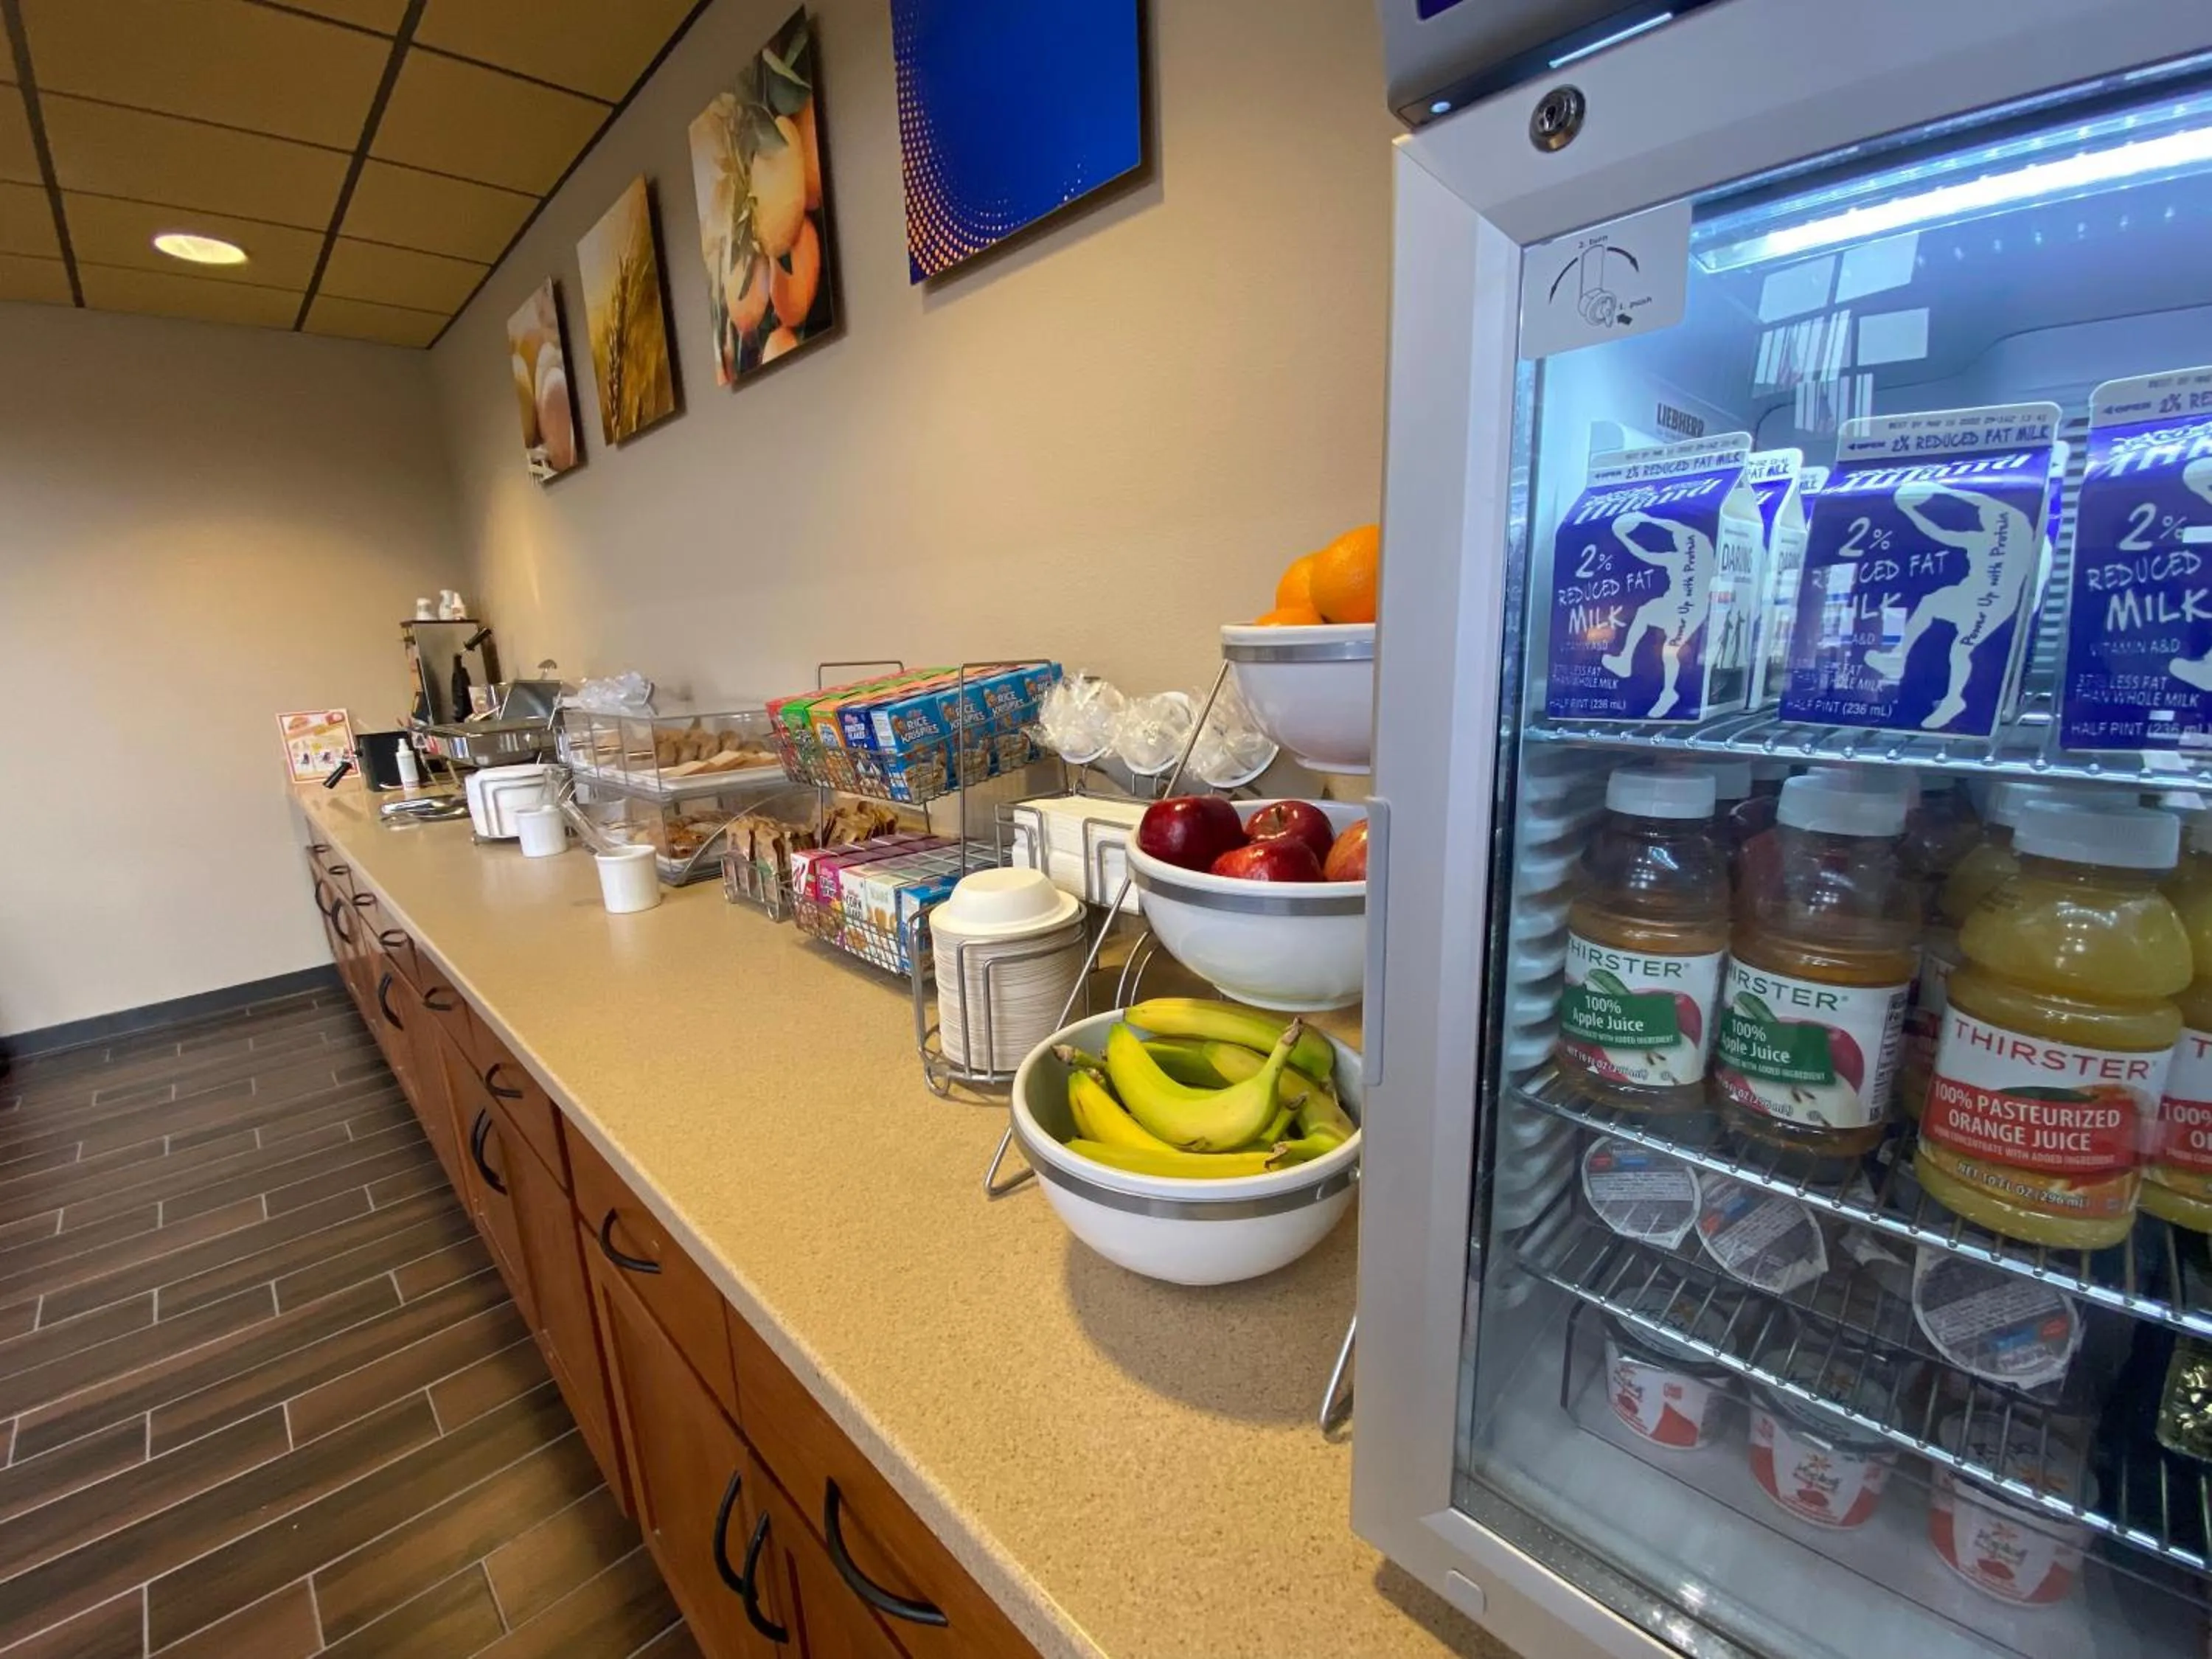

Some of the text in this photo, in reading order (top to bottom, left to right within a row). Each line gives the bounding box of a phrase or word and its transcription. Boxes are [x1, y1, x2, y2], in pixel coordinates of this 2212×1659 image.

[1891, 434, 1910, 452] 2%
[1916, 431, 1979, 450] REDUCED
[1985, 428, 2012, 443] FAT
[2015, 425, 2050, 440] MILK
[1626, 466, 1639, 479] 2%
[1643, 459, 1690, 476] REDUCED
[1694, 456, 1711, 468] FAT
[1716, 452, 1740, 464] MILK
[1767, 464, 1789, 476] MILK
[1837, 517, 1894, 557] 2%
[2119, 503, 2188, 550] 2%
[1576, 544, 1613, 578] 2%
[1908, 551, 1950, 577] FAT
[2087, 550, 2202, 591] REDUCED
[1558, 569, 1655, 605] REDUCED FAT
[1988, 561, 2003, 588] with
[1678, 601, 1694, 614] Up
[1977, 591, 2000, 611] Up
[2107, 588, 2212, 631] MILK
[1568, 605, 1627, 635] MILK
[1960, 612, 1987, 647] Power
[2110, 674, 2138, 689] LESS
[2142, 675, 2168, 690] FAT
[1815, 700, 1840, 714] PINT
[2114, 691, 2161, 706] WHOLE
[2164, 693, 2199, 707] MILK
[901, 724, 940, 743] KRISPIES
[907, 716, 928, 730] RICE
[2110, 722, 2143, 736] PINT
[1570, 936, 1683, 978] HIRSTER
[1585, 995, 1621, 1014] 100%
[1573, 1007, 1604, 1029] Apple
[1607, 1016, 1644, 1032] Juice
[1732, 1019, 1767, 1042] 100%
[1750, 1043, 1790, 1063] Juice
[1955, 1018, 2151, 1082] THIRSTER
[1934, 1079, 2120, 1129] 100% PASTEURIZED
[1948, 1108, 2092, 1152] ORANGE JUICE
[2005, 1146, 2028, 1160] WITH
[1958, 1161, 1978, 1178] NET
